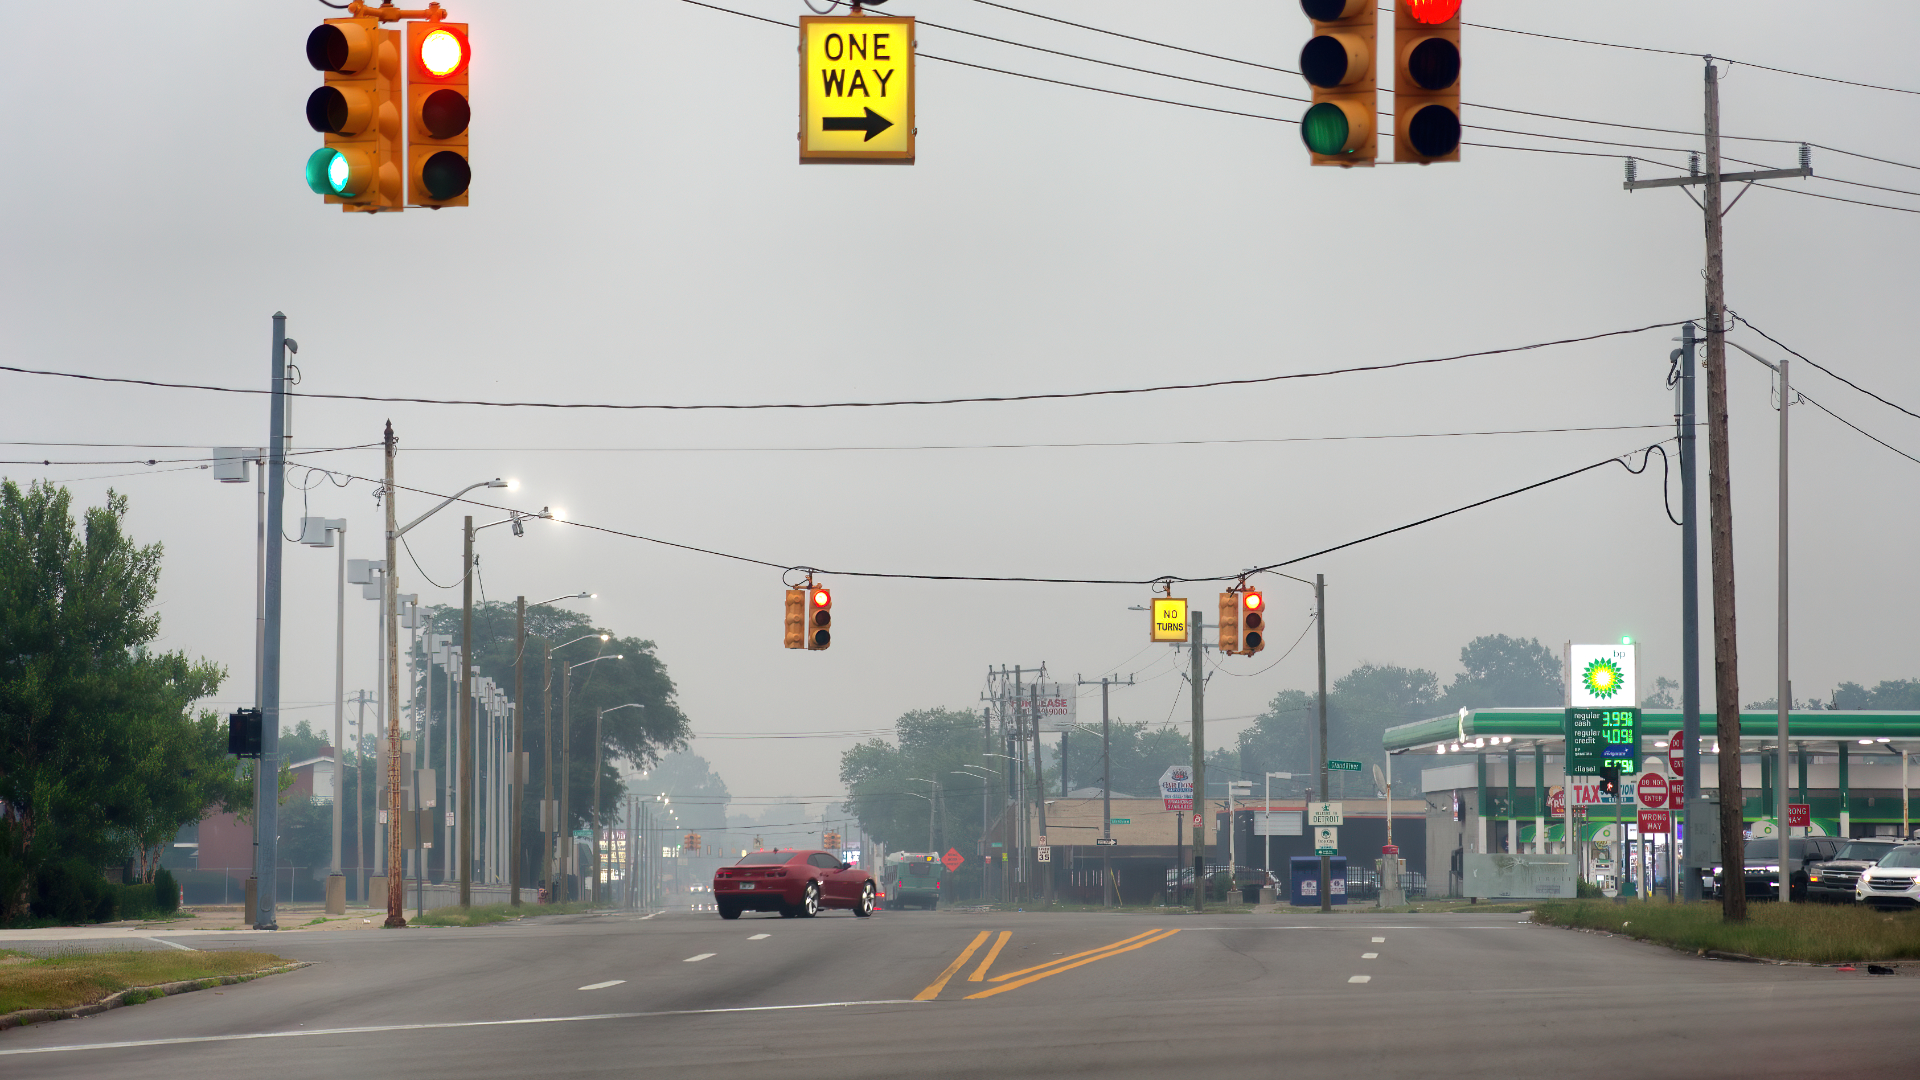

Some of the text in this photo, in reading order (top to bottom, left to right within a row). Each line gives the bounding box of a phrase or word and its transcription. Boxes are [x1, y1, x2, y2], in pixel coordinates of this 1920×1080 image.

[824, 33, 890, 61] ONE
[822, 69, 895, 97] WAY
[1163, 609, 1178, 618] NO
[1156, 622, 1184, 631] TURNS
[1613, 649, 1626, 659] bp
[1574, 711, 1601, 720] regular
[1602, 711, 1629, 727] 3.99
[1574, 719, 1591, 727] cash
[1574, 729, 1601, 738] regular
[1602, 729, 1629, 744] 4.09
[1671, 784, 1684, 794] WRO
[1573, 784, 1602, 804] TAX
[1788, 807, 1807, 815] RONG
[1313, 815, 1340, 823] DETROIT
[1641, 813, 1667, 821] WRONG
[1788, 816, 1802, 824] AY
